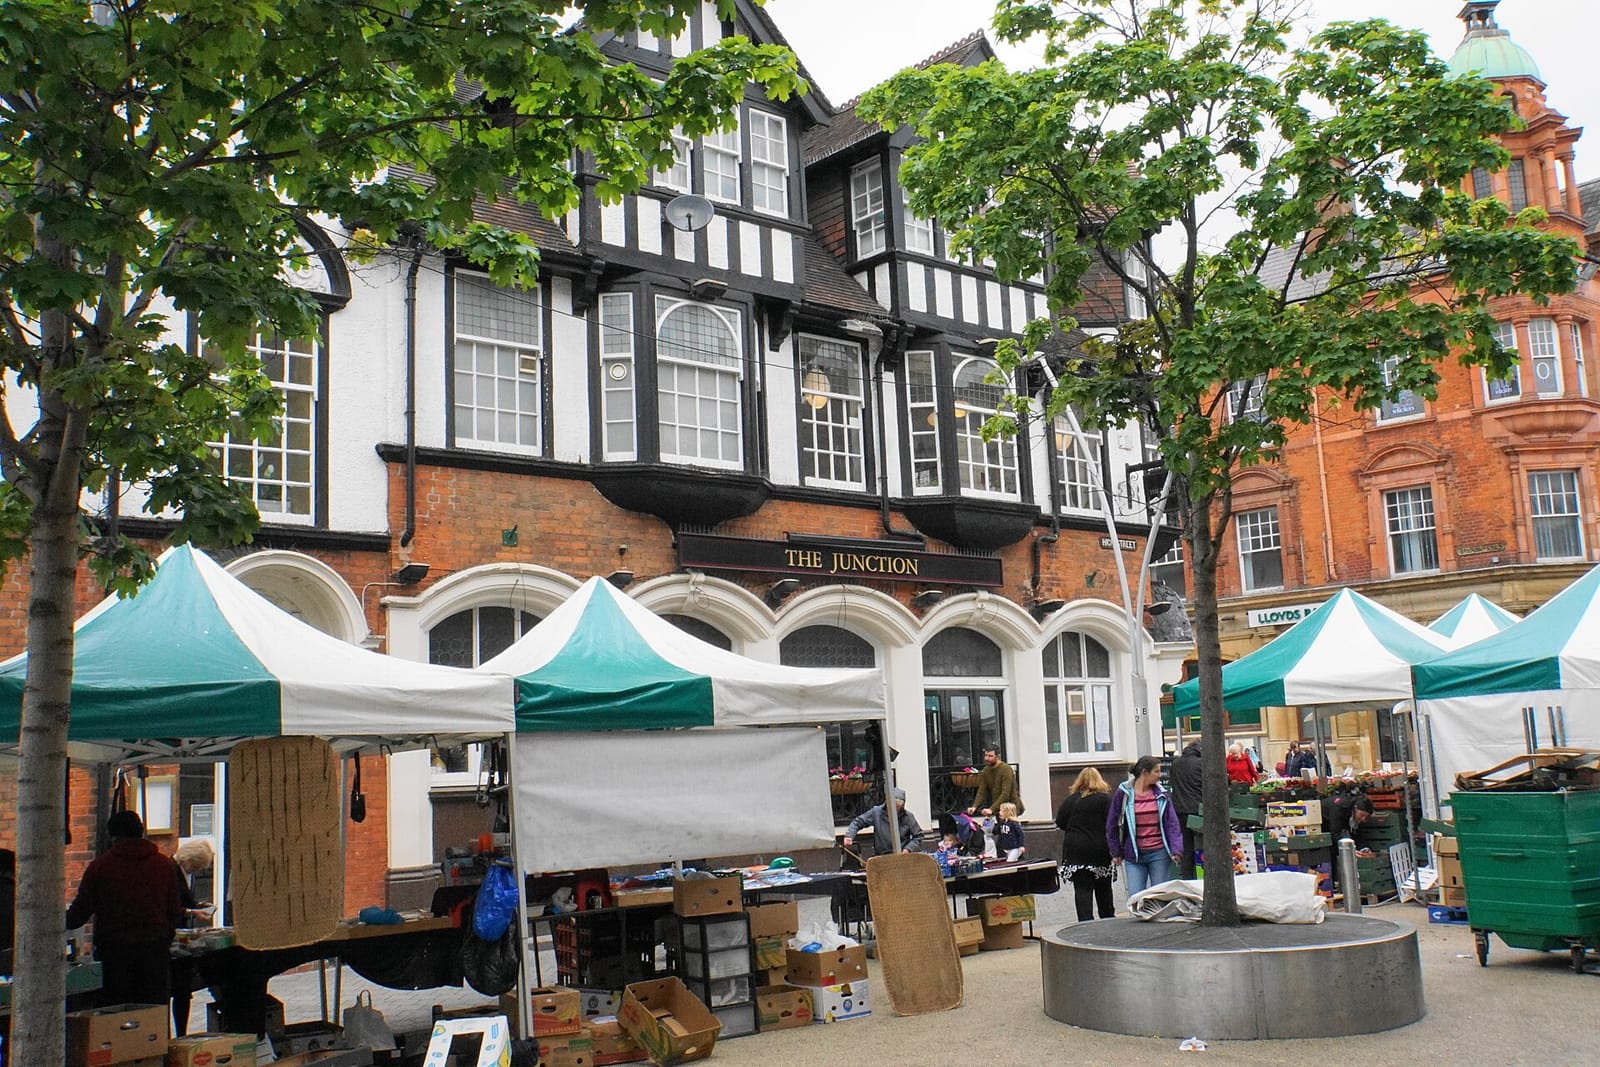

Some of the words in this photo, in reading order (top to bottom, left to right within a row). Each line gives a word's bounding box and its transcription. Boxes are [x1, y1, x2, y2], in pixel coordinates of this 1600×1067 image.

[785, 549, 823, 568] THE
[830, 552, 919, 576] JUNCTION
[1258, 610, 1301, 623] LLOYDS
